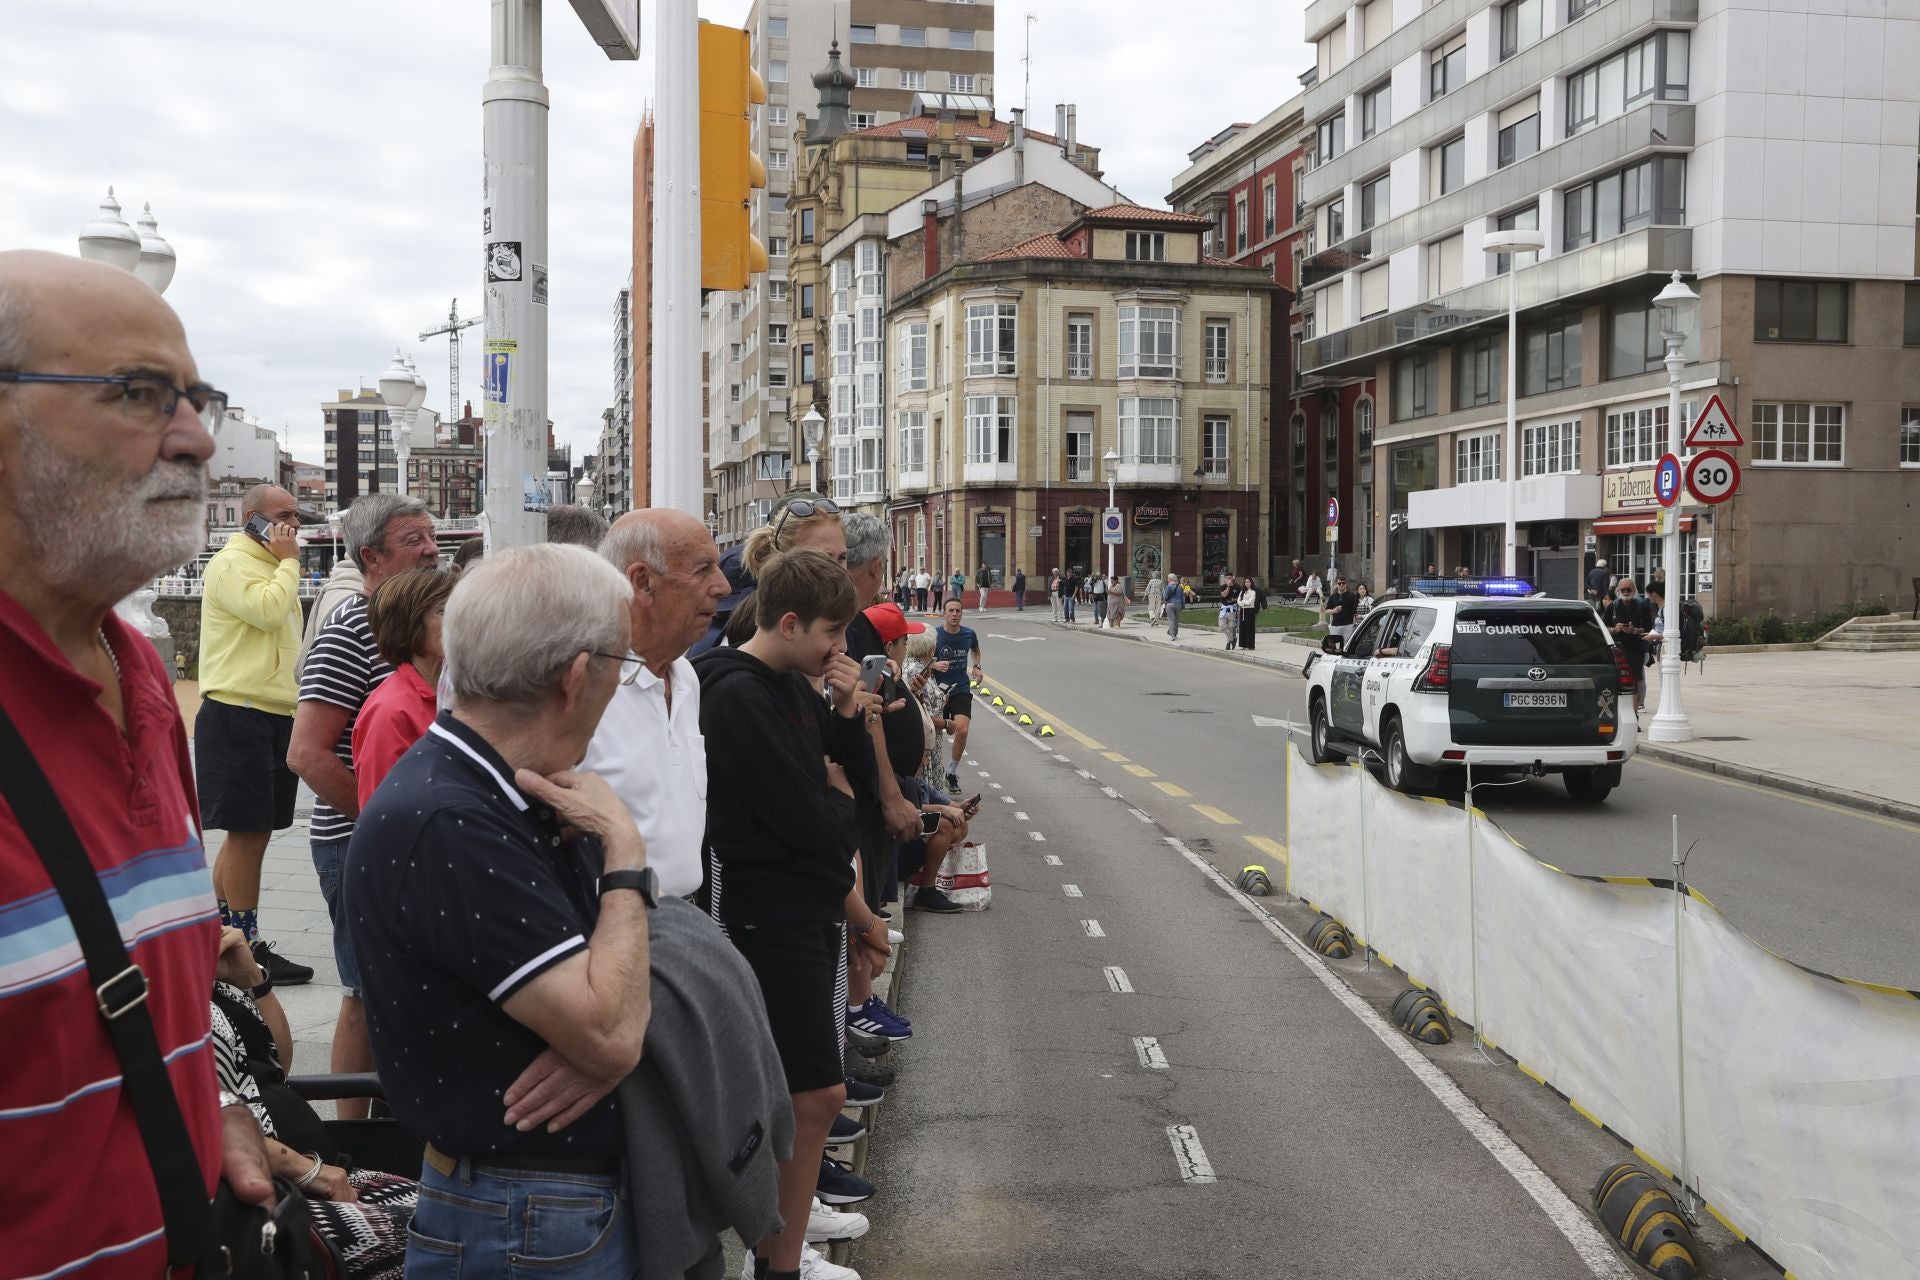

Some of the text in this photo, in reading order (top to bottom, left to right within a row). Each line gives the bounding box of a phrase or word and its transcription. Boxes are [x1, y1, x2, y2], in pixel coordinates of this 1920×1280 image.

[1664, 472, 1670, 488] P
[1698, 468, 1727, 485] 30
[1607, 475, 1651, 498] La Taberna
[1135, 507, 1169, 516] UTOPIA
[1486, 625, 1576, 636] GUARDIA CIVIL
[1510, 694, 1566, 706] PGC 9936 N
